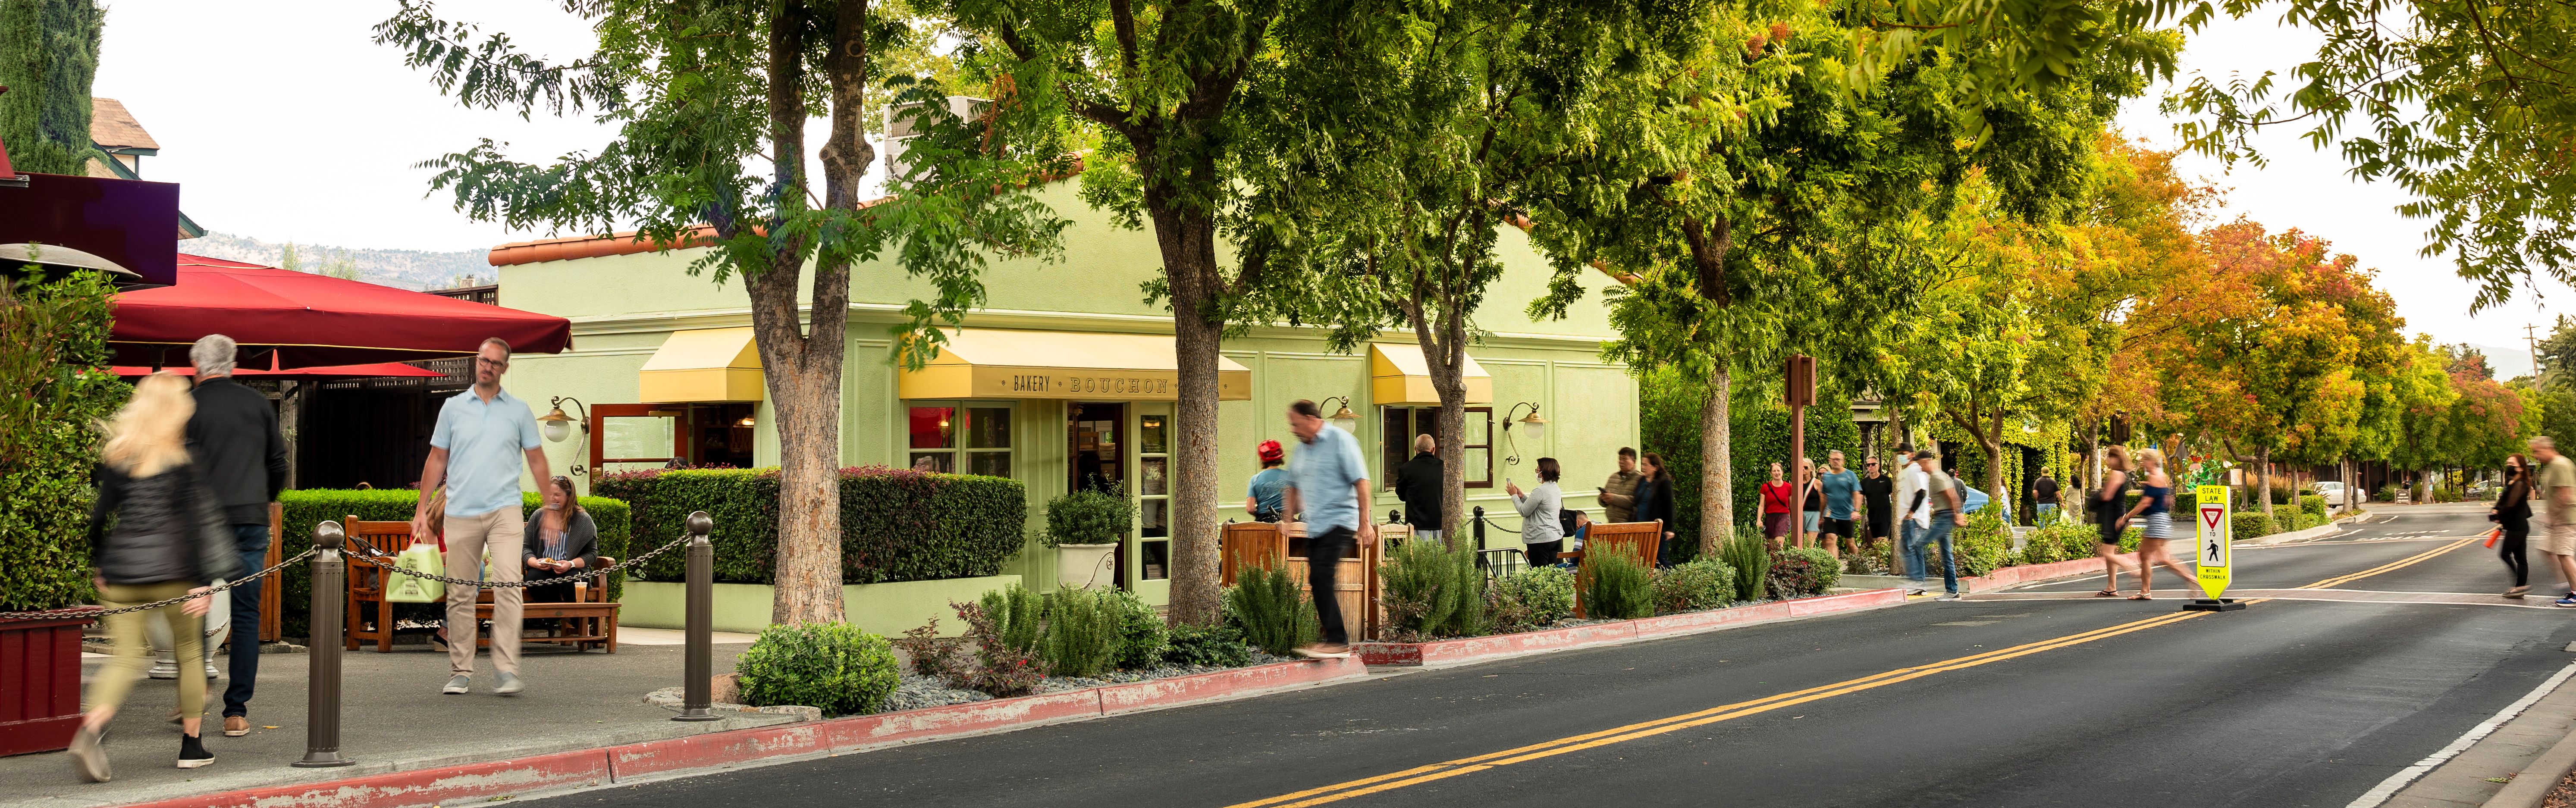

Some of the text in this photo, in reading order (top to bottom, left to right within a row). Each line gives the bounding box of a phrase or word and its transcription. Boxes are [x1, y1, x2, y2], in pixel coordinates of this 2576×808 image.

[1014, 375, 1168, 393] BAKERY BOUCHON
[404, 557, 418, 595] BAKRY
